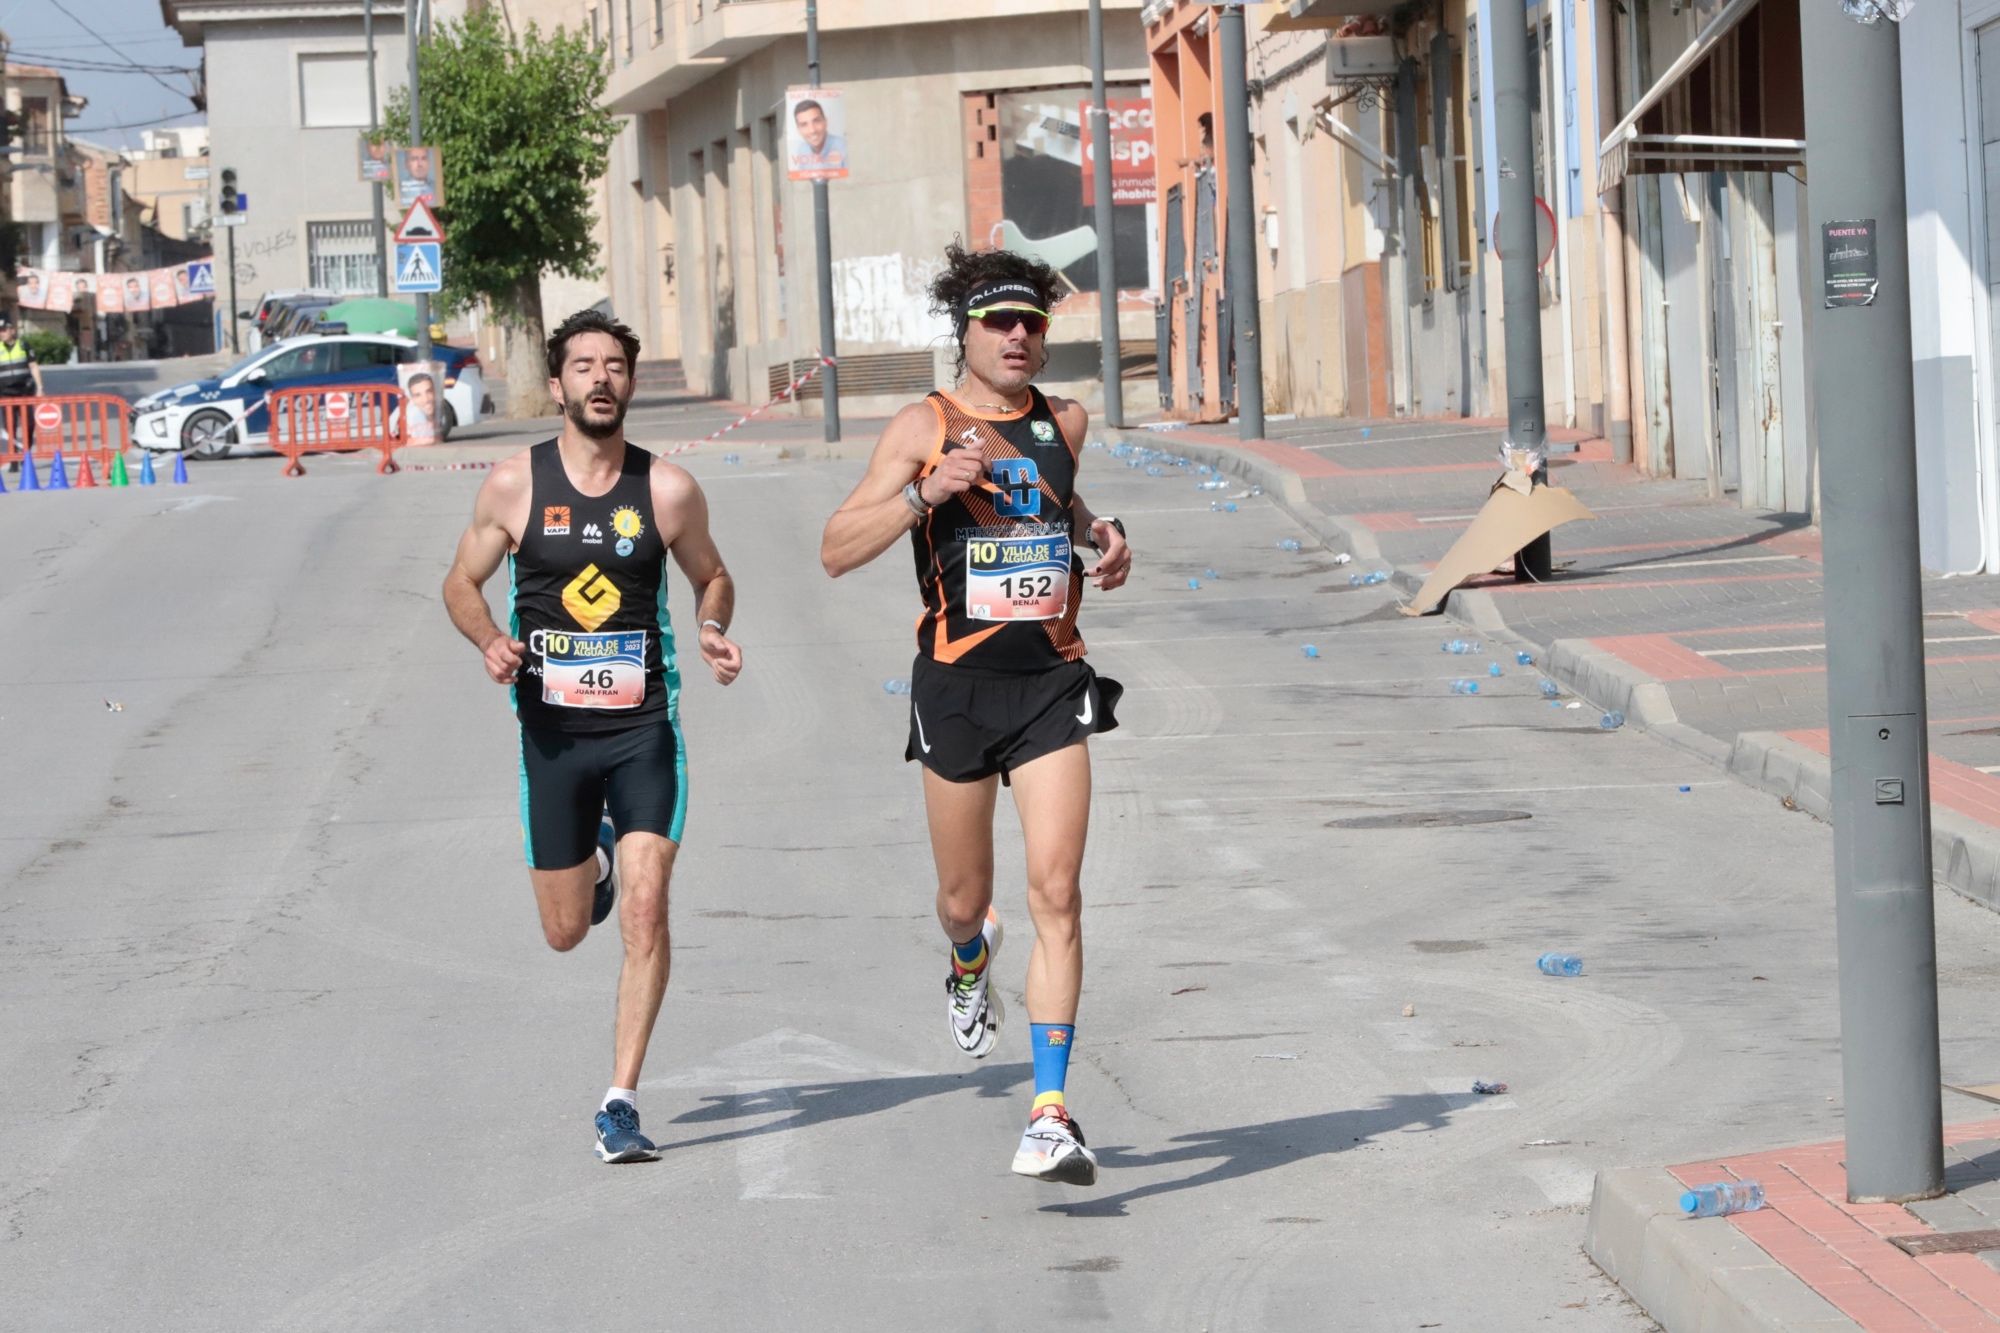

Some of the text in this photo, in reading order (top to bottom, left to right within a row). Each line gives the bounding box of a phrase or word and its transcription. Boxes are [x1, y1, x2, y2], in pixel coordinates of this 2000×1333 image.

[1828, 227, 1868, 237] PUENTE YA
[984, 284, 1038, 298] LURBEL
[1002, 545, 1034, 556] VILLA
[1036, 544, 1050, 554] DE
[1001, 553, 1050, 564] ALGUAZAS
[999, 575, 1052, 599] 152
[573, 640, 604, 650] VILLA
[606, 639, 619, 650] DE
[573, 647, 619, 657] ALGUAZAS
[578, 669, 614, 689] 46
